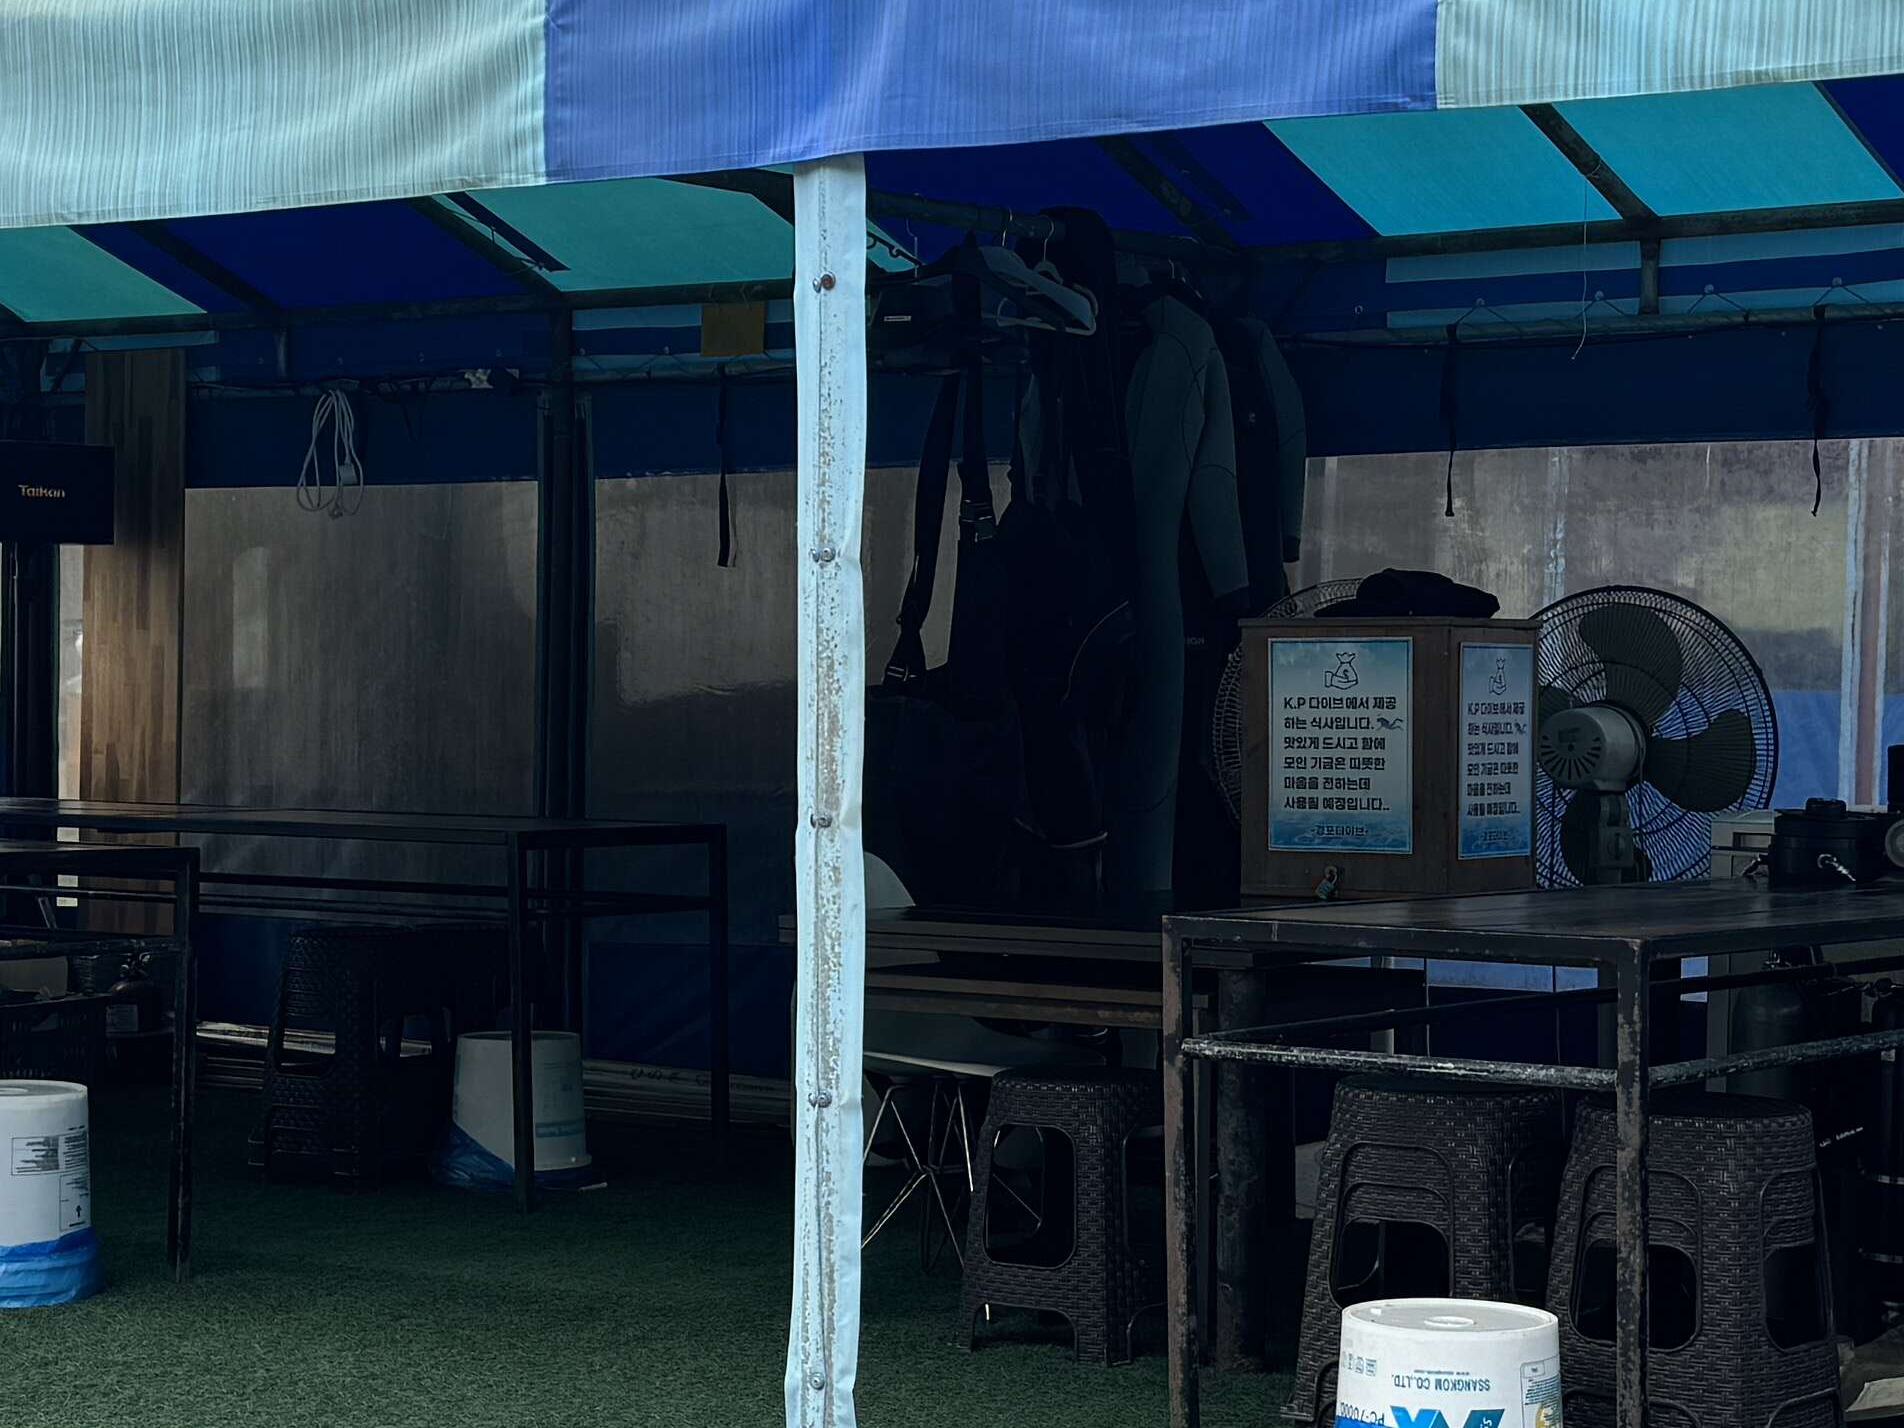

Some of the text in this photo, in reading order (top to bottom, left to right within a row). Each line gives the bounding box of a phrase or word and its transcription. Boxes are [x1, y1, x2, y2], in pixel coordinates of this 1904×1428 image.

[17, 484, 67, 498] Taikan
[1284, 696, 1397, 710] K.P 다이브에서 제공
[1284, 716, 1375, 730] 하는 식사입니다.
[1284, 737, 1386, 750] 맛있게 드시고 함에
[1283, 756, 1386, 771] 모인 기금은 따뜻한
[1284, 776, 1371, 790] 마음을 전하는데
[1284, 796, 1319, 810] 사용될
